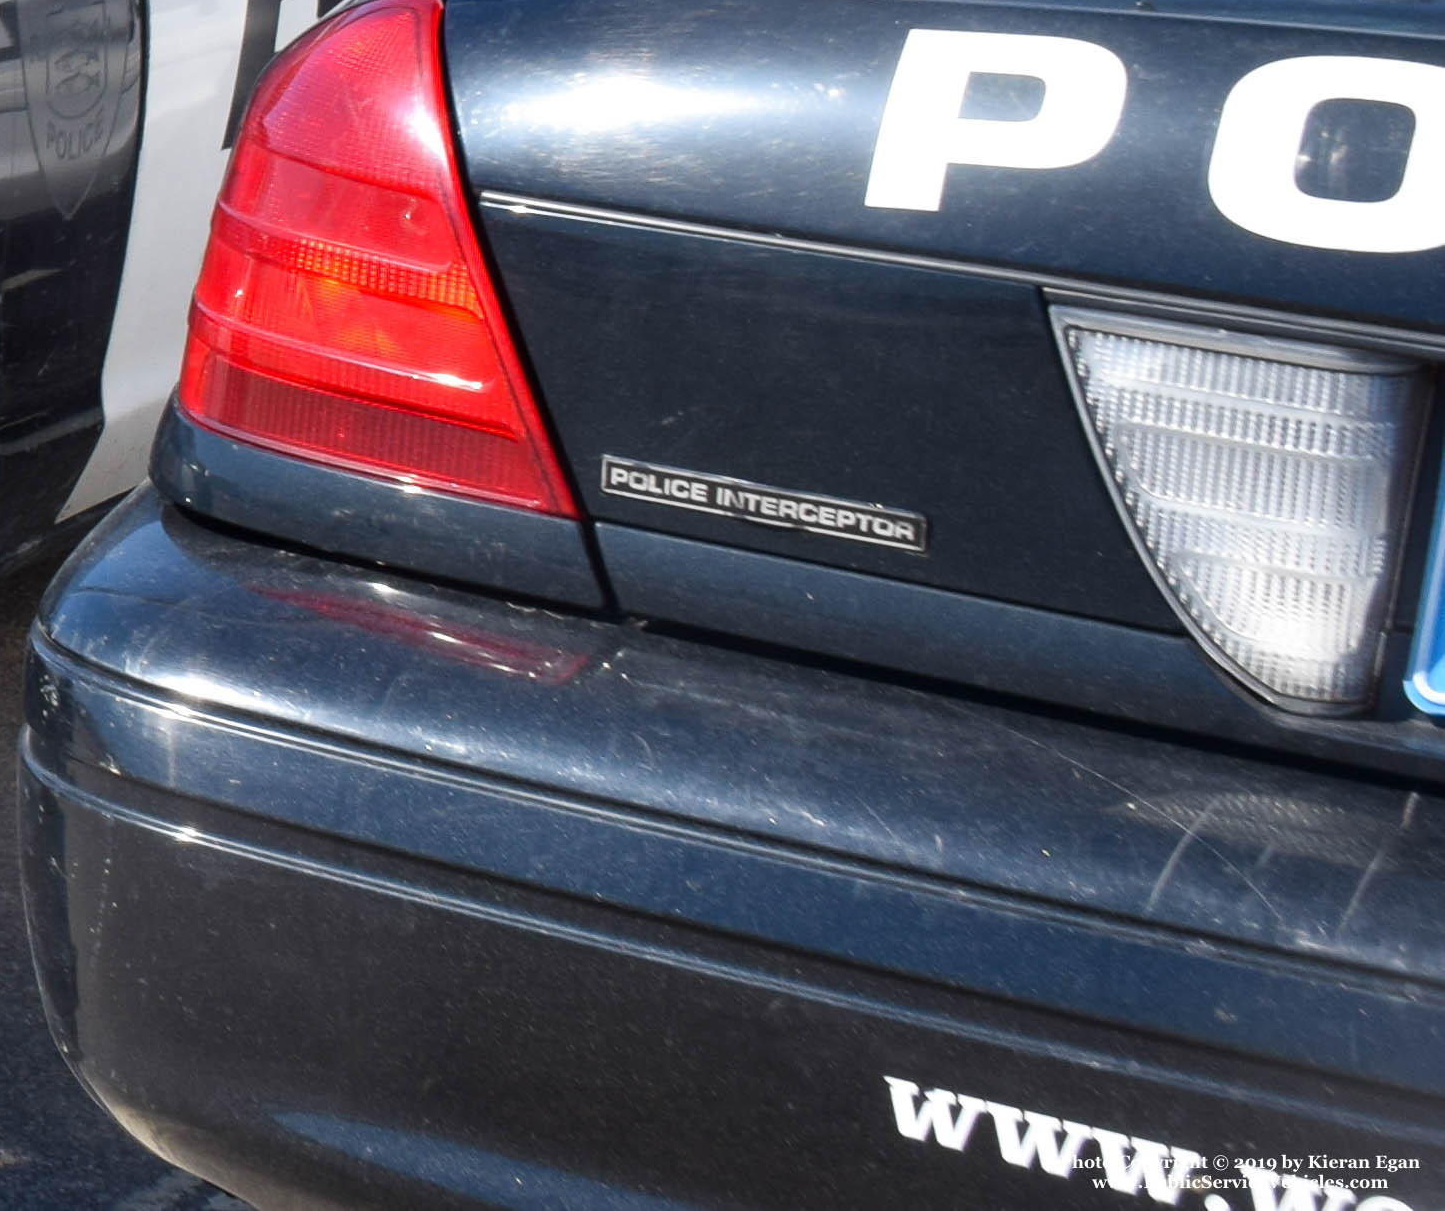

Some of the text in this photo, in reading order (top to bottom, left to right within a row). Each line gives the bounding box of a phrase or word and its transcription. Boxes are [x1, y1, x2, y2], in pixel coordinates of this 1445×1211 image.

[46, 108, 104, 161] POLICE
[610, 466, 917, 542] POLICE INTERCEPTOR
